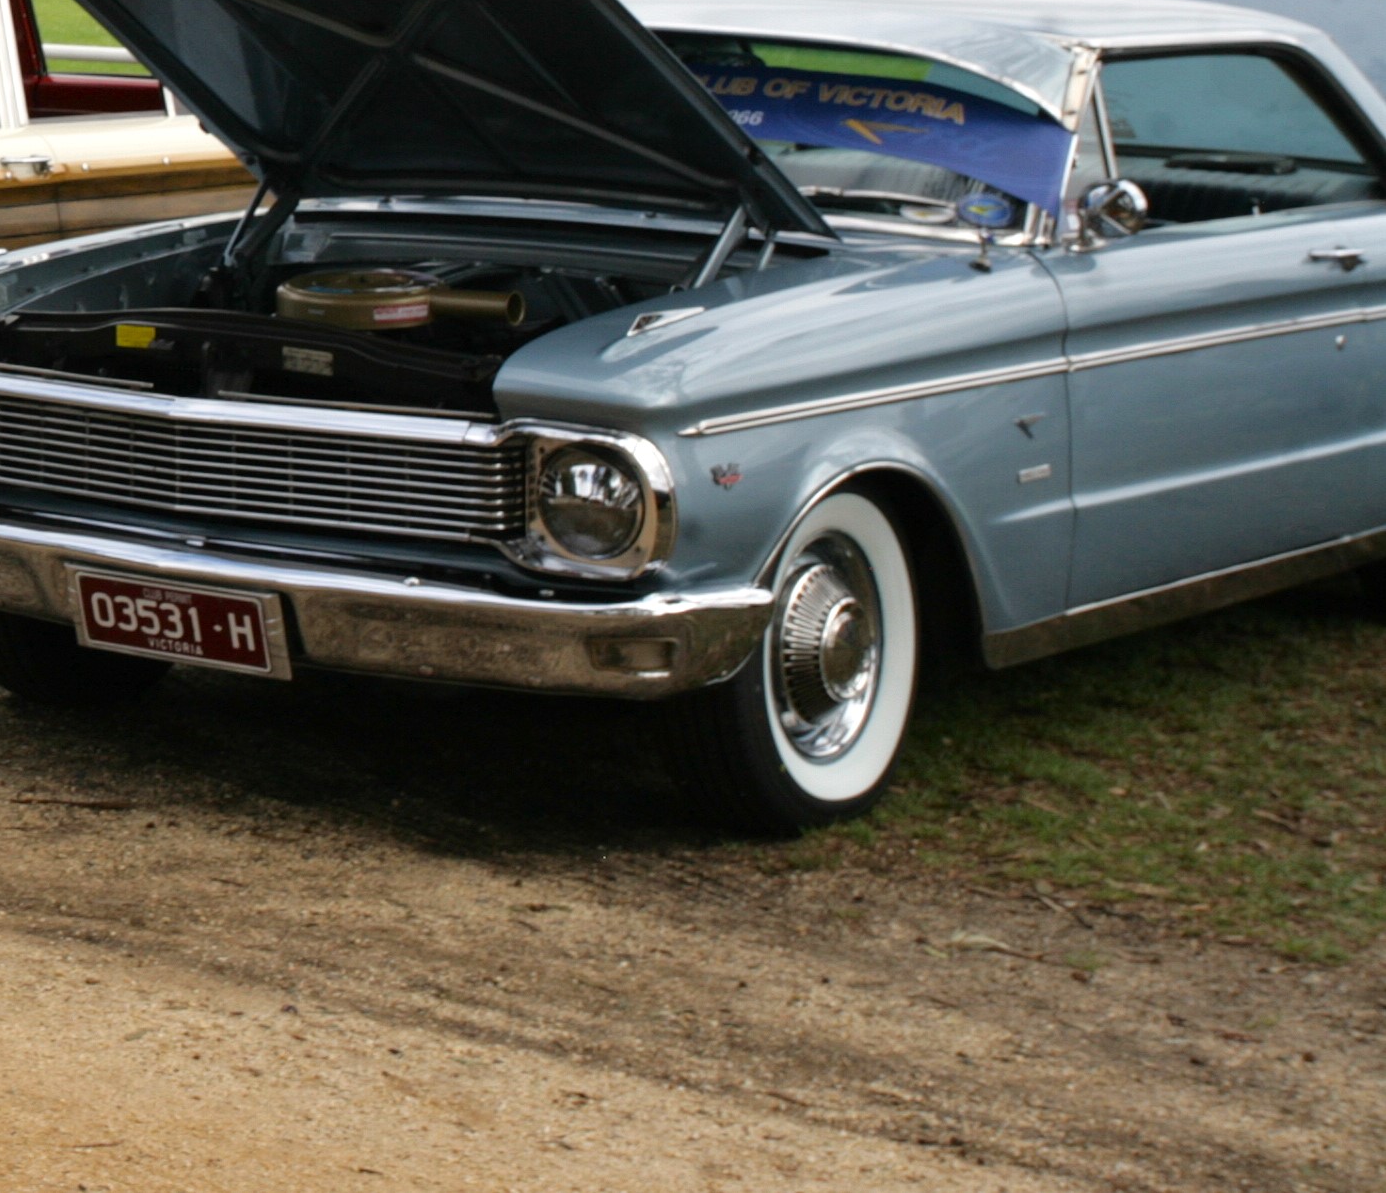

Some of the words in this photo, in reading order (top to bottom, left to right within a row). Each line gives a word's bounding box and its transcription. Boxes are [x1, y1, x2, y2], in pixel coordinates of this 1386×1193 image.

[698, 75, 757, 96] LUB
[763, 77, 812, 99] OF
[818, 84, 966, 125] VICTORIA
[147, 638, 204, 656] VICTORIA
